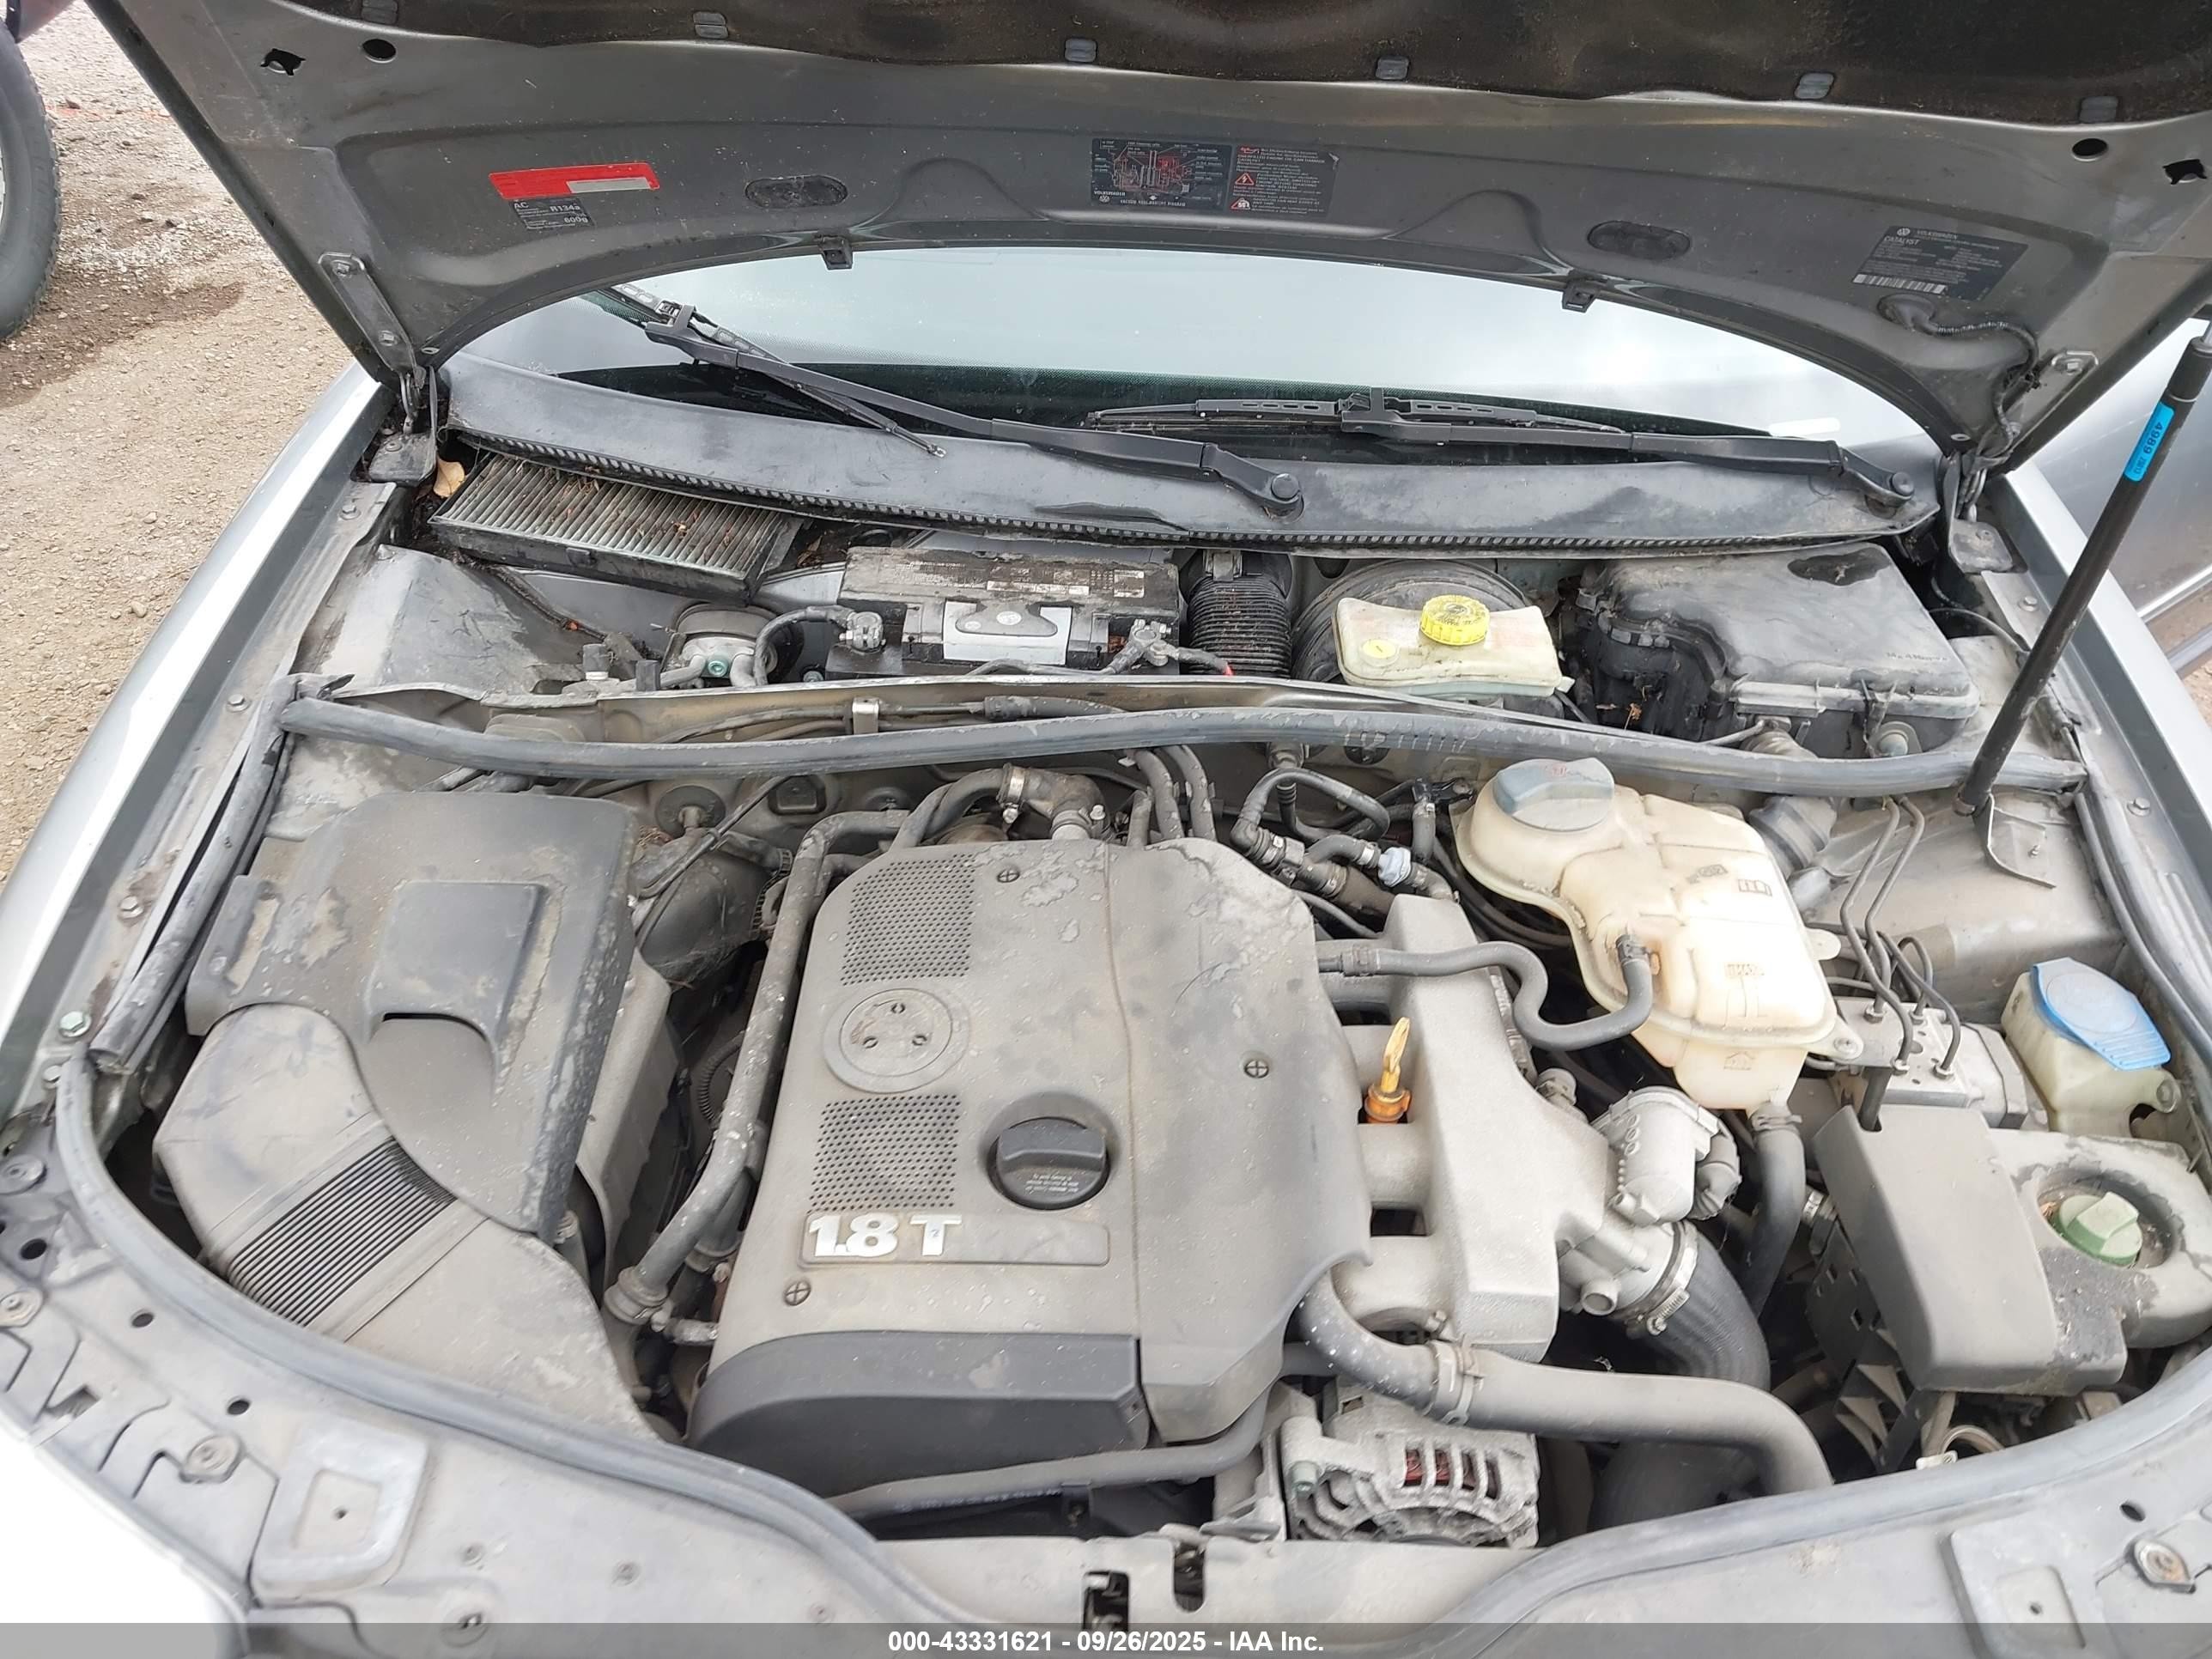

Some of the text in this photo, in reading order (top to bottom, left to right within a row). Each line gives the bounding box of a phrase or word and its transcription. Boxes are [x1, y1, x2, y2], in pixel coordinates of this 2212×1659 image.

[1884, 235, 1920, 246] CATALYST
[2143, 422, 2163, 454] 4989
[910, 1213, 963, 1257] T
